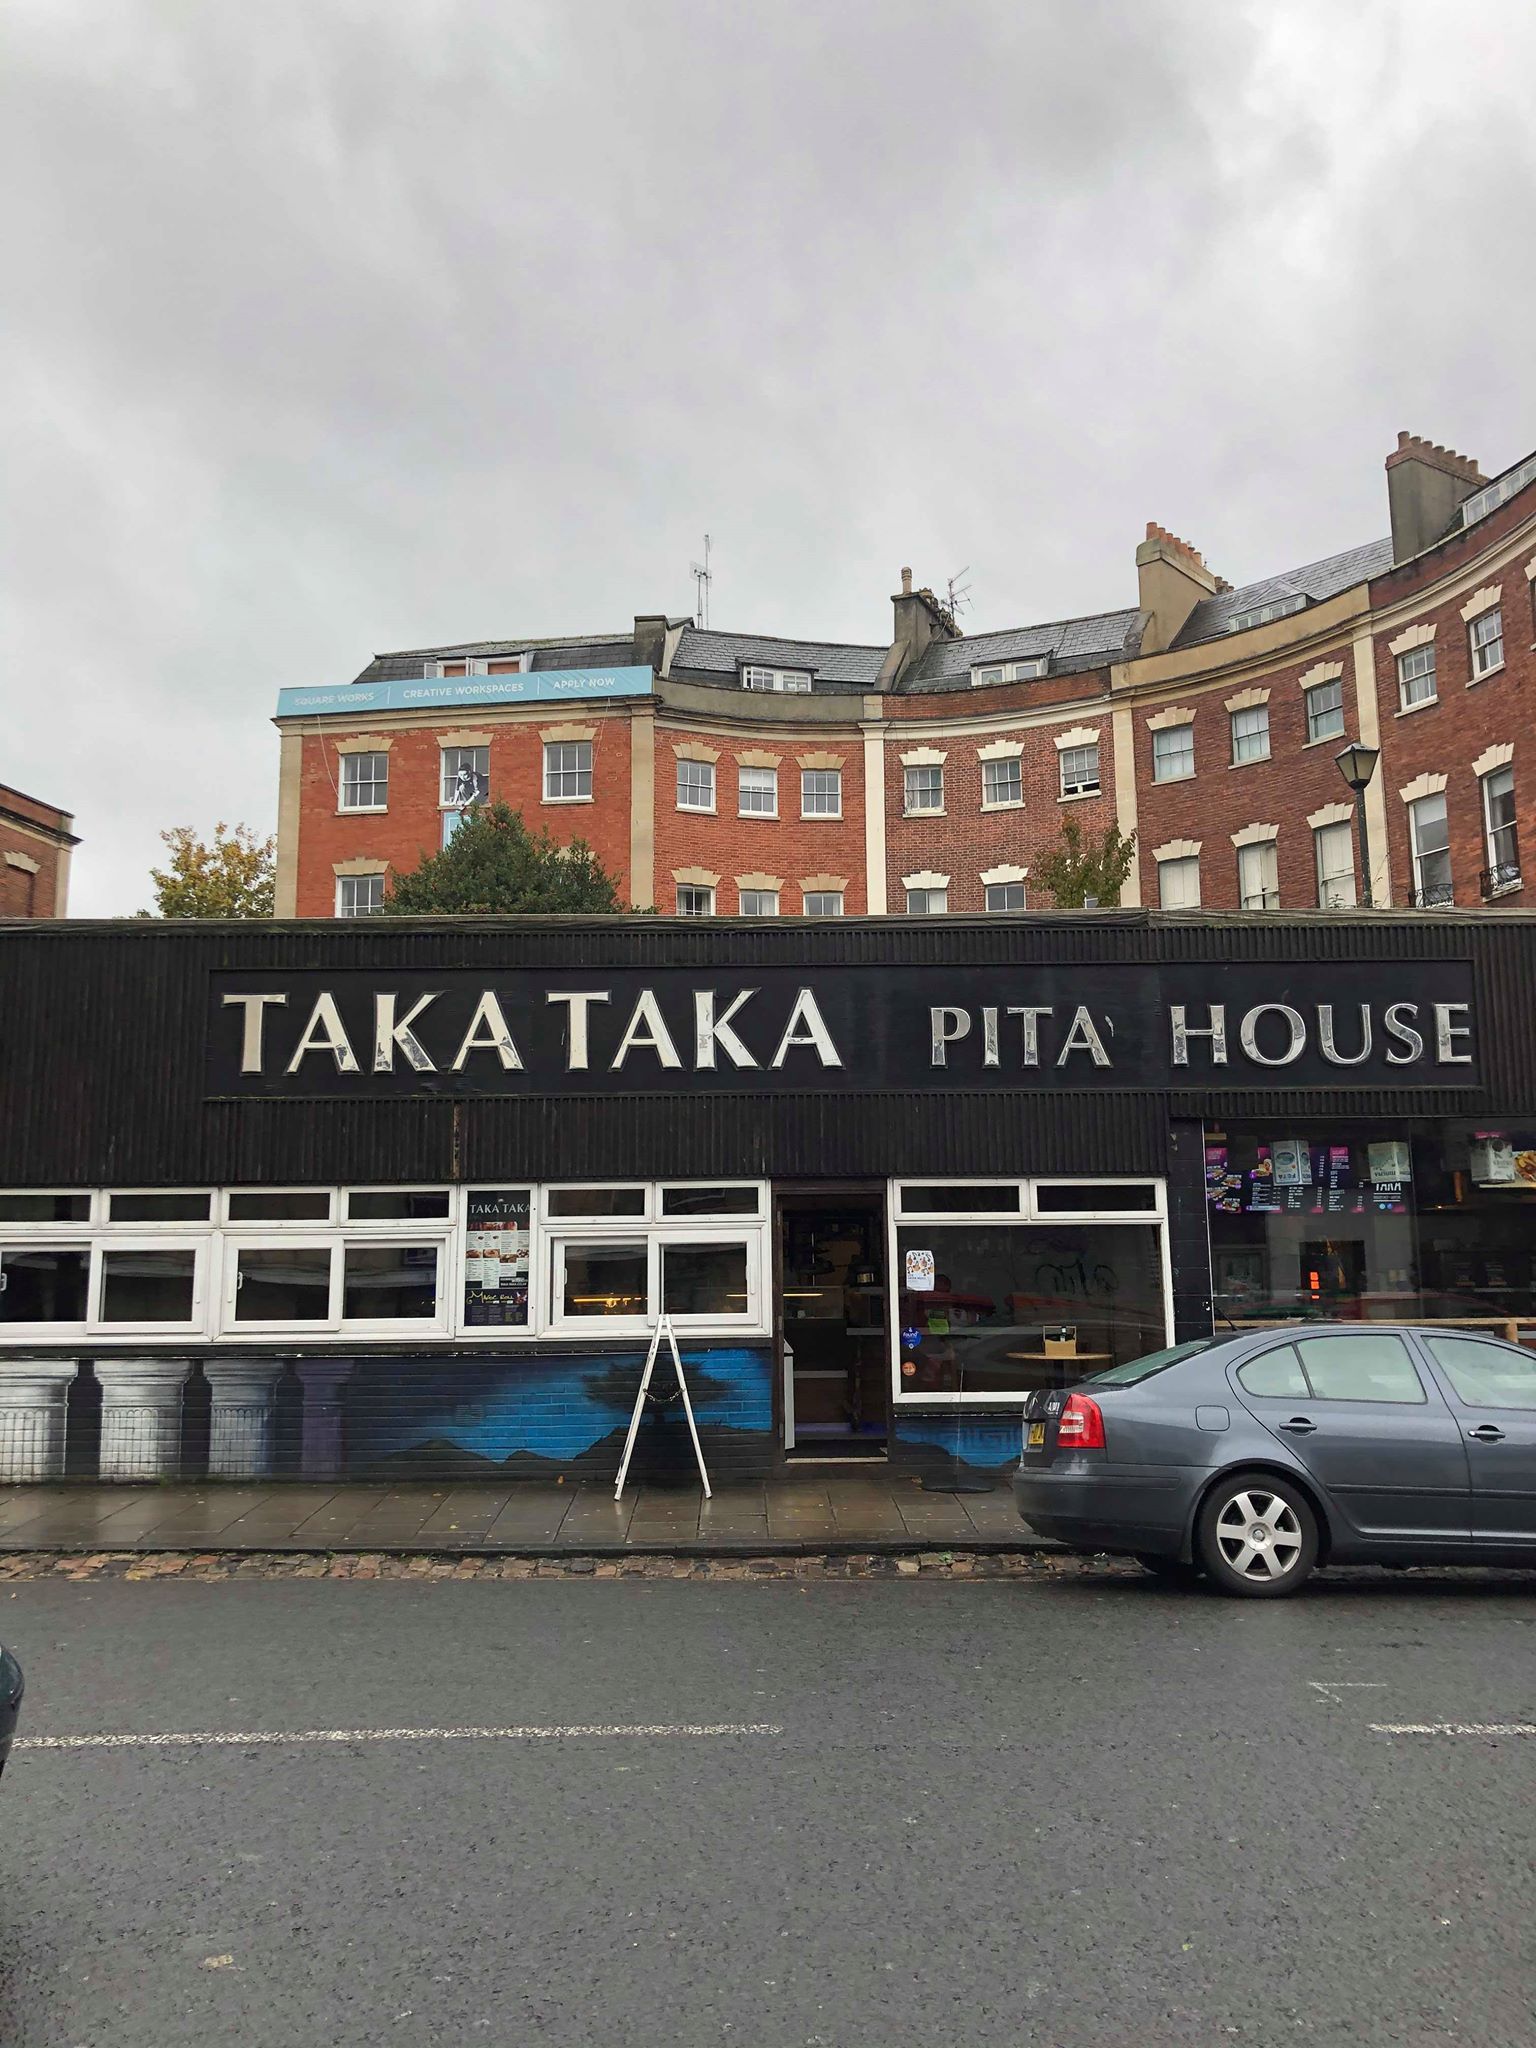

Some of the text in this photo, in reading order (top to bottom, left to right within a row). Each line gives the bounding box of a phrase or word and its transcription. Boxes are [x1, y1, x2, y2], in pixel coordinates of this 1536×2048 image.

[294, 677, 616, 706] SQUARE WORKS CREATIVE WORKSPACES APPLY NOW
[223, 987, 1473, 1073] TAKA TAKA PITA HOUSE
[469, 1203, 530, 1214] TAKA TAKA
